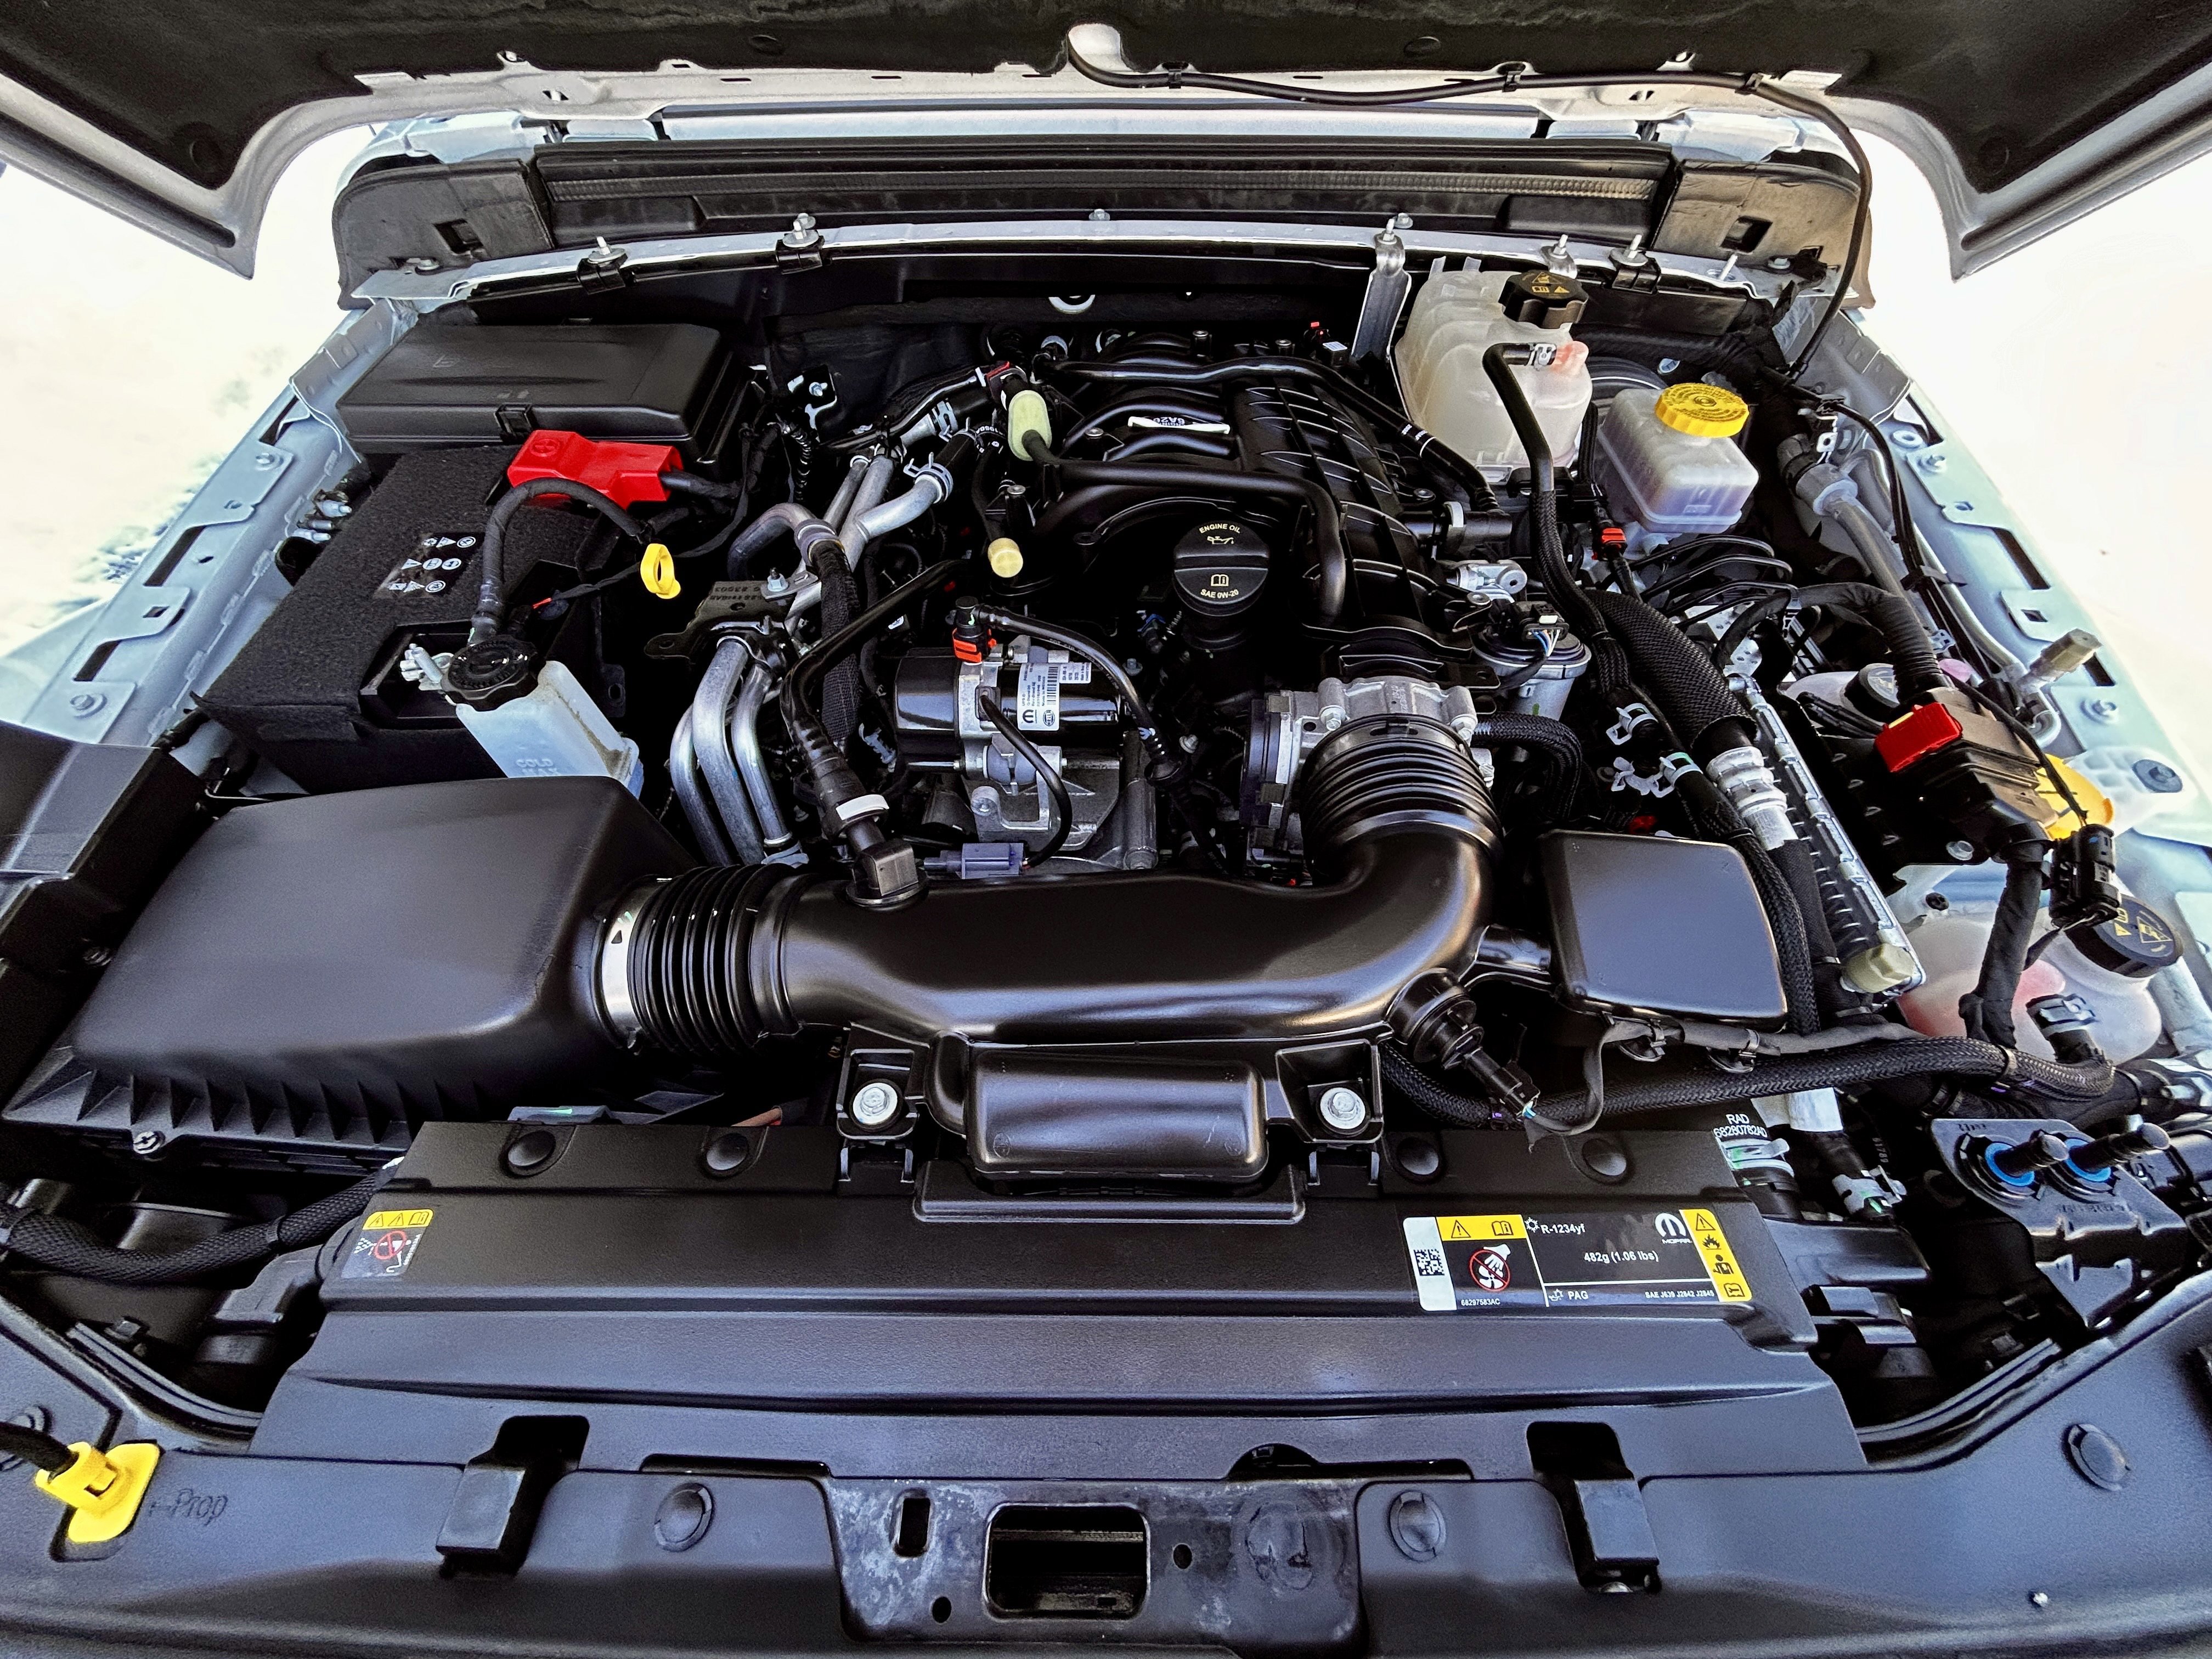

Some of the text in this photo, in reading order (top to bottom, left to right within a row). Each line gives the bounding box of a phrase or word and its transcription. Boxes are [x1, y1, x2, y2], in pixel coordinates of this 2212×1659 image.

[1199, 523, 1241, 534] ENGINE OIL
[1200, 589, 1239, 599] SAE 0W-20
[517, 759, 554, 768] COLD
[1726, 1114, 1750, 1125] RAD
[1713, 1125, 1768, 1138] 68280782AD
[1540, 1223, 1585, 1235] R-1234yf
[1584, 1250, 1659, 1264] 482g (1.06 lbs)
[1567, 1290, 1589, 1300] PAG
